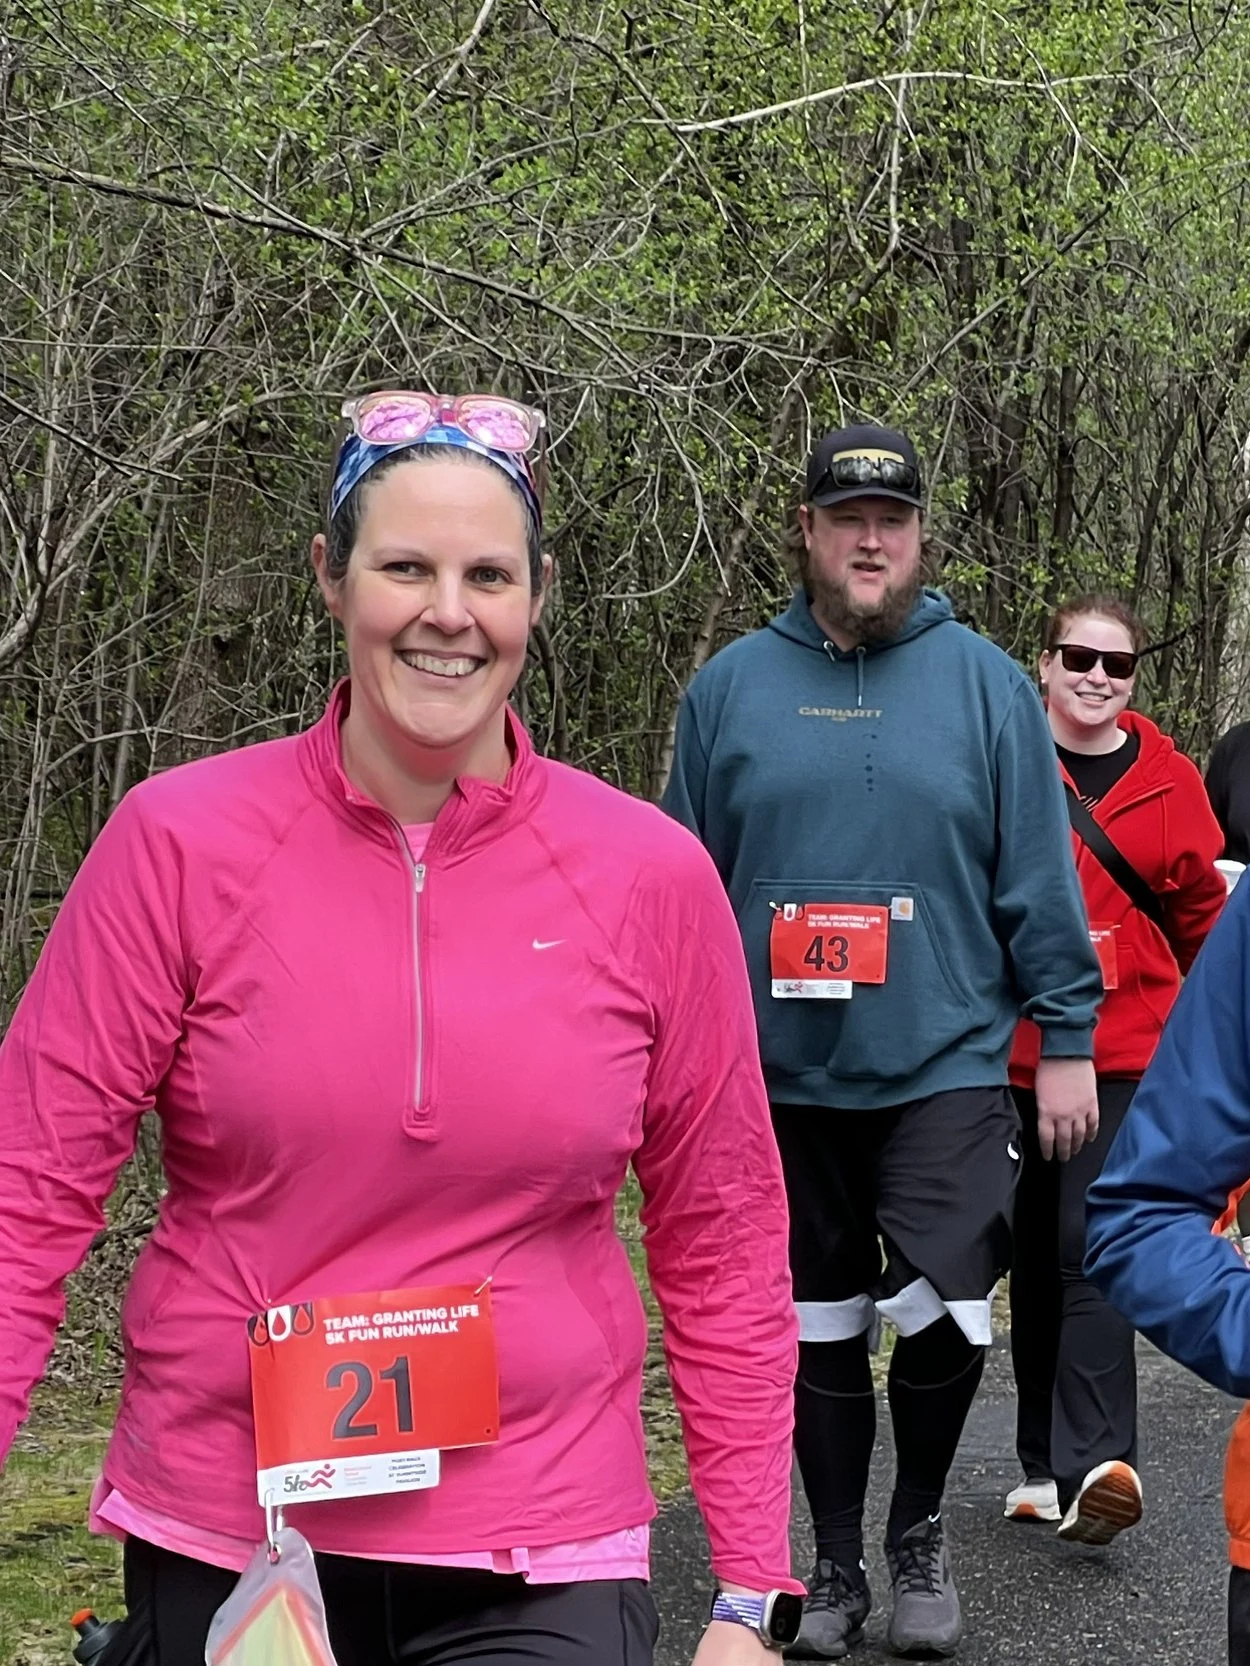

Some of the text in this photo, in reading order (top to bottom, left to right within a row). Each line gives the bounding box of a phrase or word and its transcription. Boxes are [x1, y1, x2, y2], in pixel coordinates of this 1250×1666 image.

[803, 935, 849, 973] 43
[323, 1304, 480, 1331] TEAM: GRANTING LIFE
[325, 1320, 459, 1345] 5K FUN RUN/WALK
[326, 1355, 415, 1440] 21
